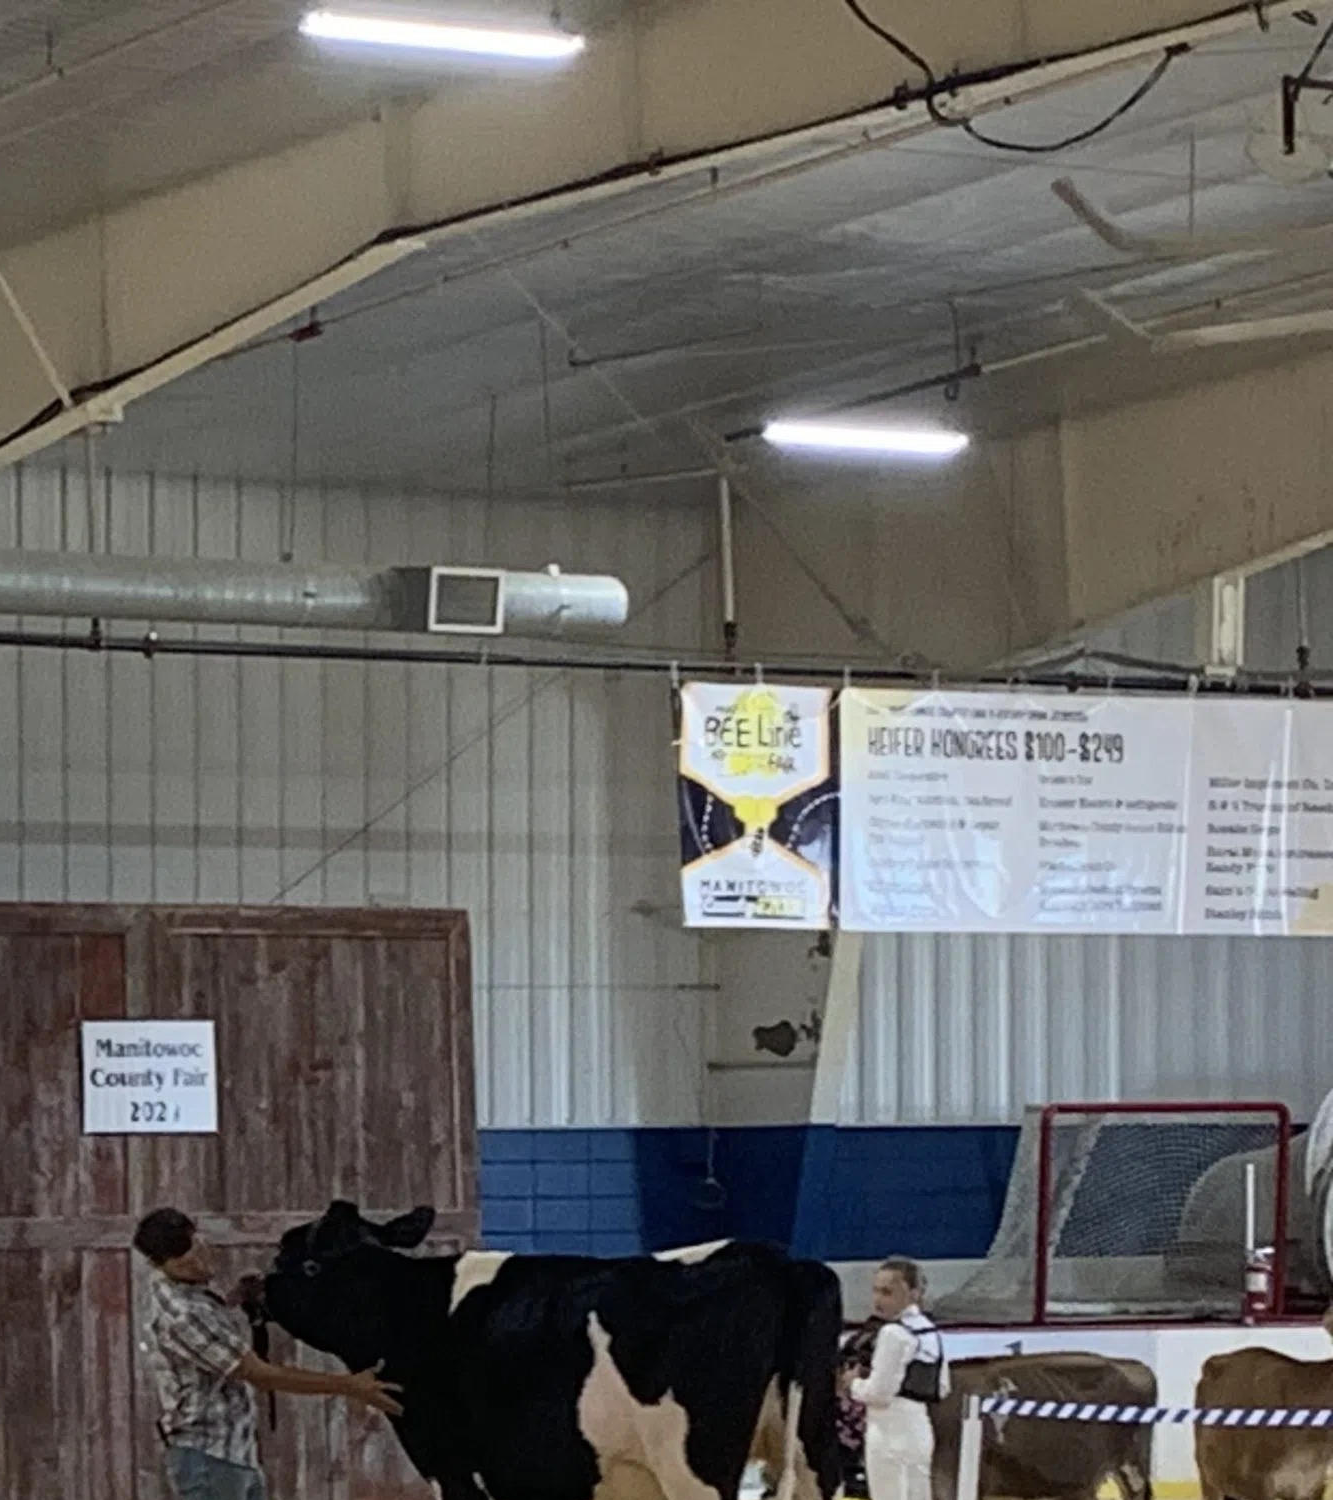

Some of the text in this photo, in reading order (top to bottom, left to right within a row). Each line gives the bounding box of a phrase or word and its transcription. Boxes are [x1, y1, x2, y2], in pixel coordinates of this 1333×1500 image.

[868, 727, 925, 757] HEIFER
[1024, 731, 1124, 763] $100-$249
[95, 1037, 203, 1058] Manitowoc
[90, 1066, 209, 1093] County Fair
